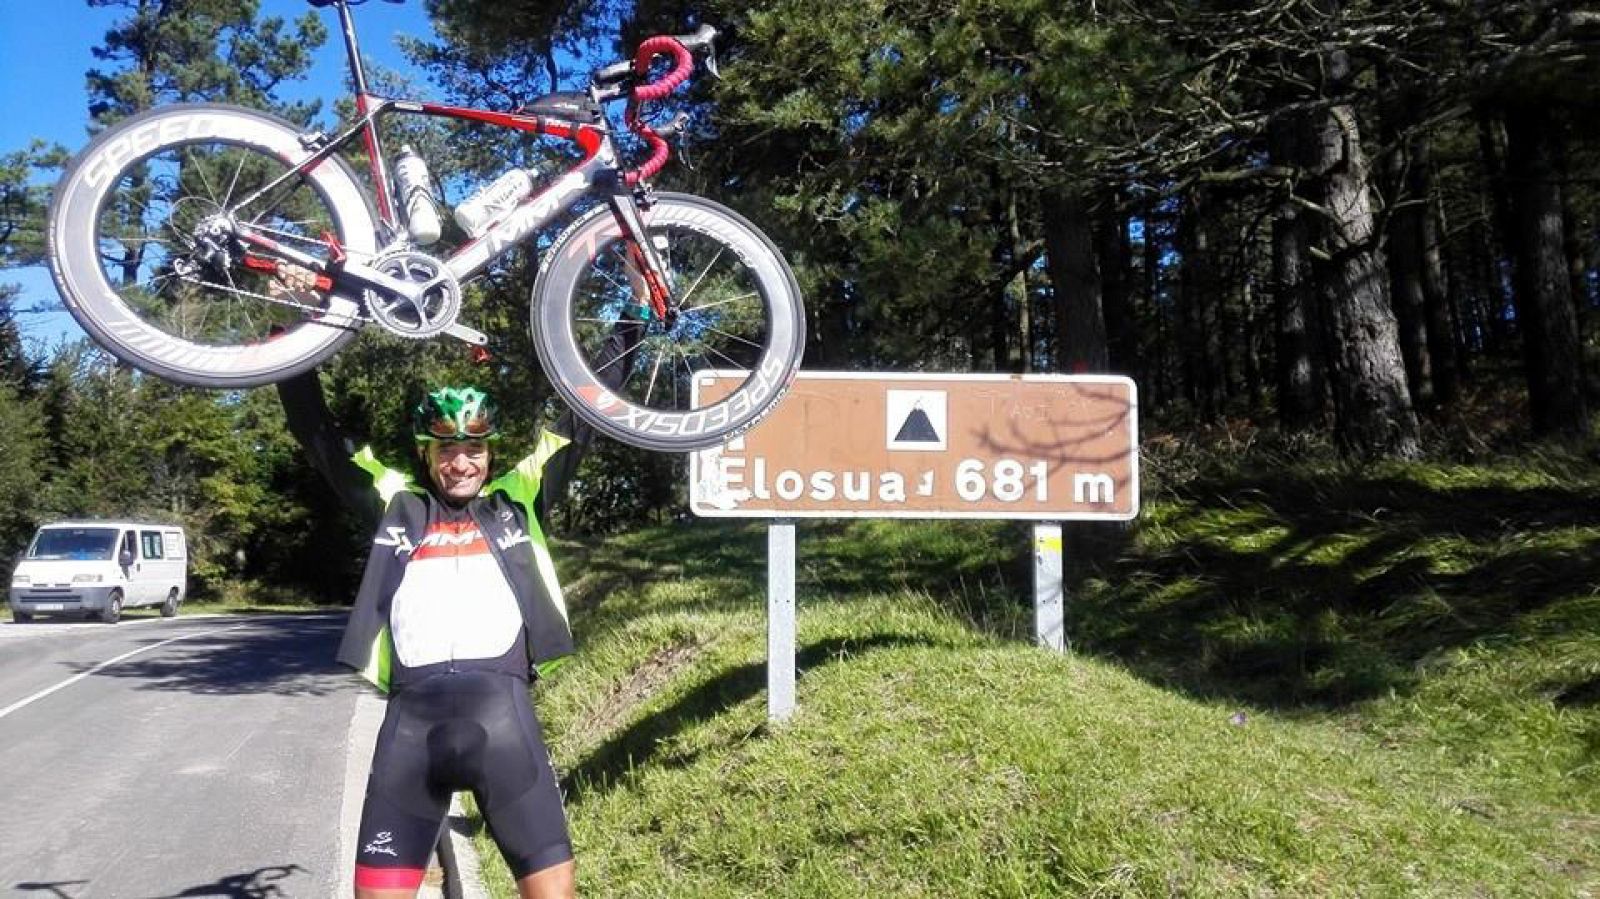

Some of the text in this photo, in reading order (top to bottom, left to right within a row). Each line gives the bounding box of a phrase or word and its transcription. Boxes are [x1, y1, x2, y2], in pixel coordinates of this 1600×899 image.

[719, 456, 1114, 503] Elosua 681 m
